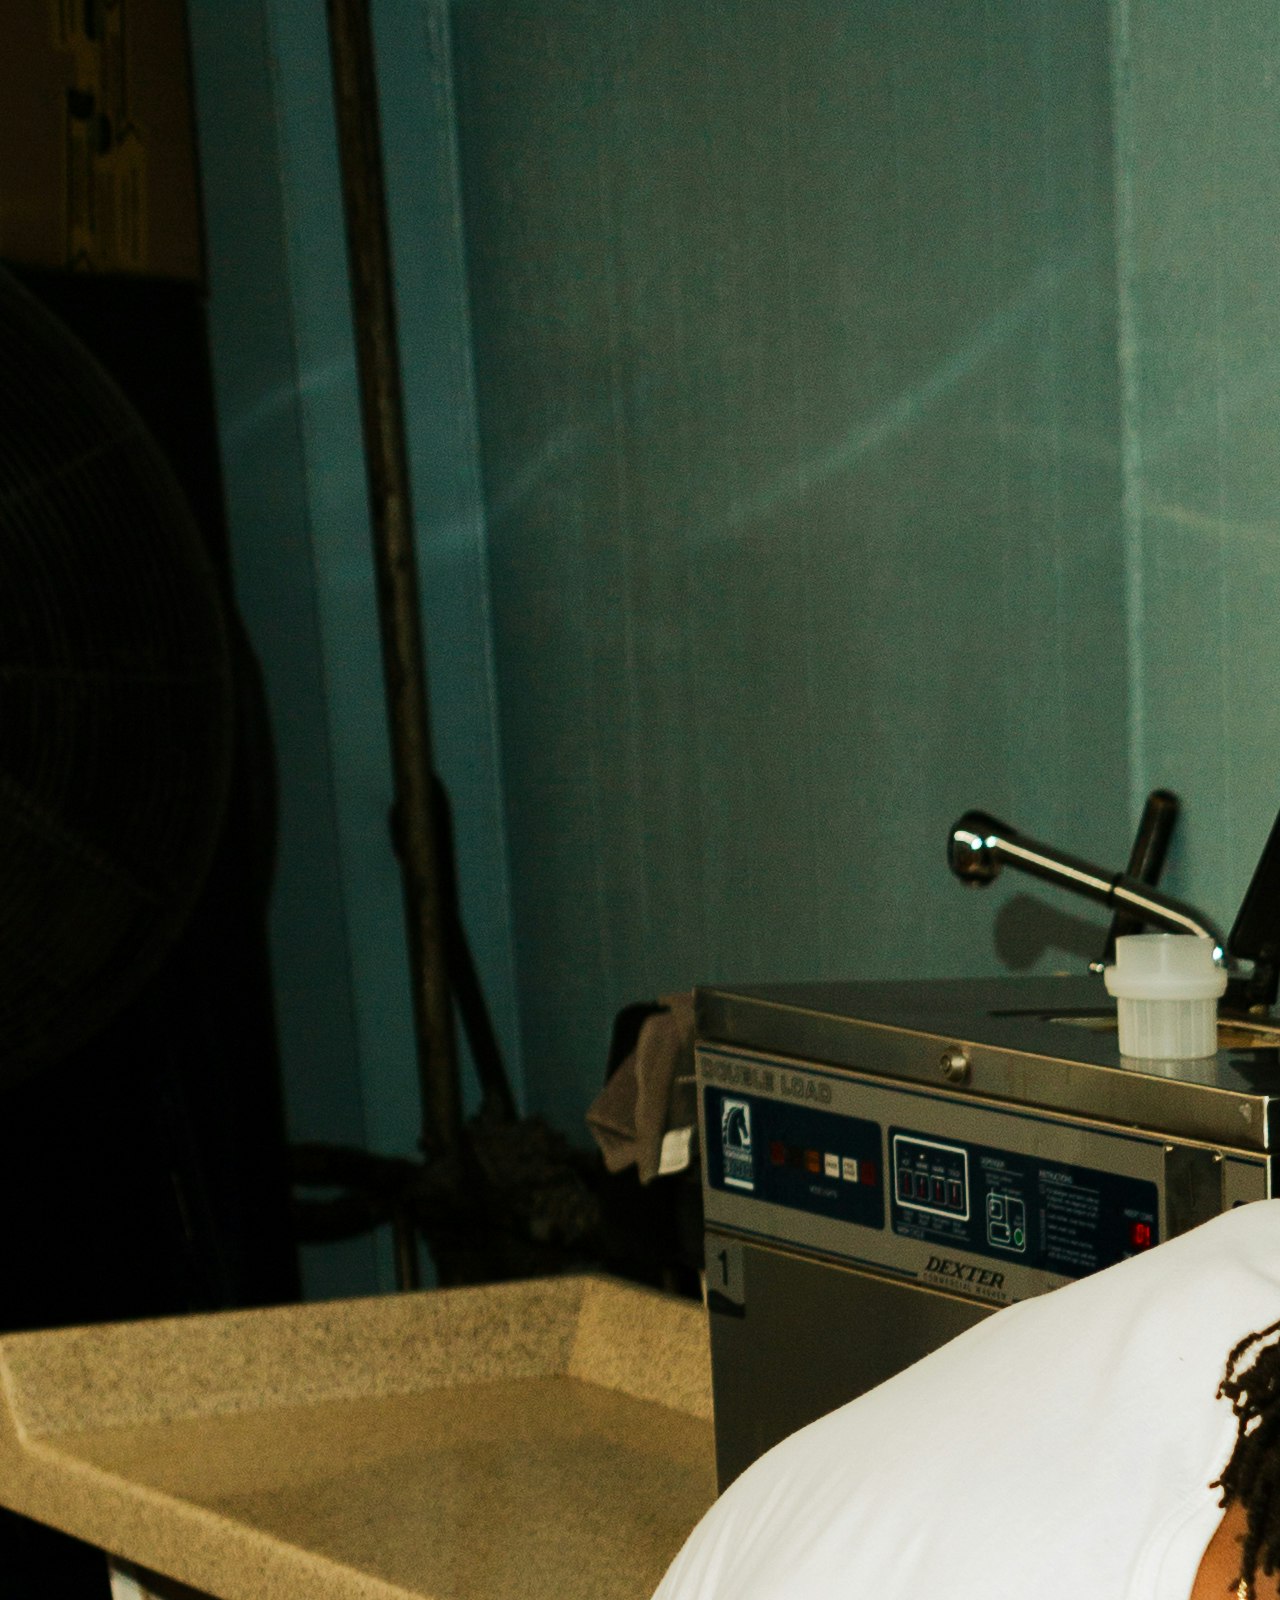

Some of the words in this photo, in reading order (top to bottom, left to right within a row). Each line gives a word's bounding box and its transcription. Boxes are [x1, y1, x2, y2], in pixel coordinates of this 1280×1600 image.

[780, 1074, 832, 1104] LOAD
[718, 1249, 729, 1286] 1
[925, 1256, 1005, 1289] DEXTER
